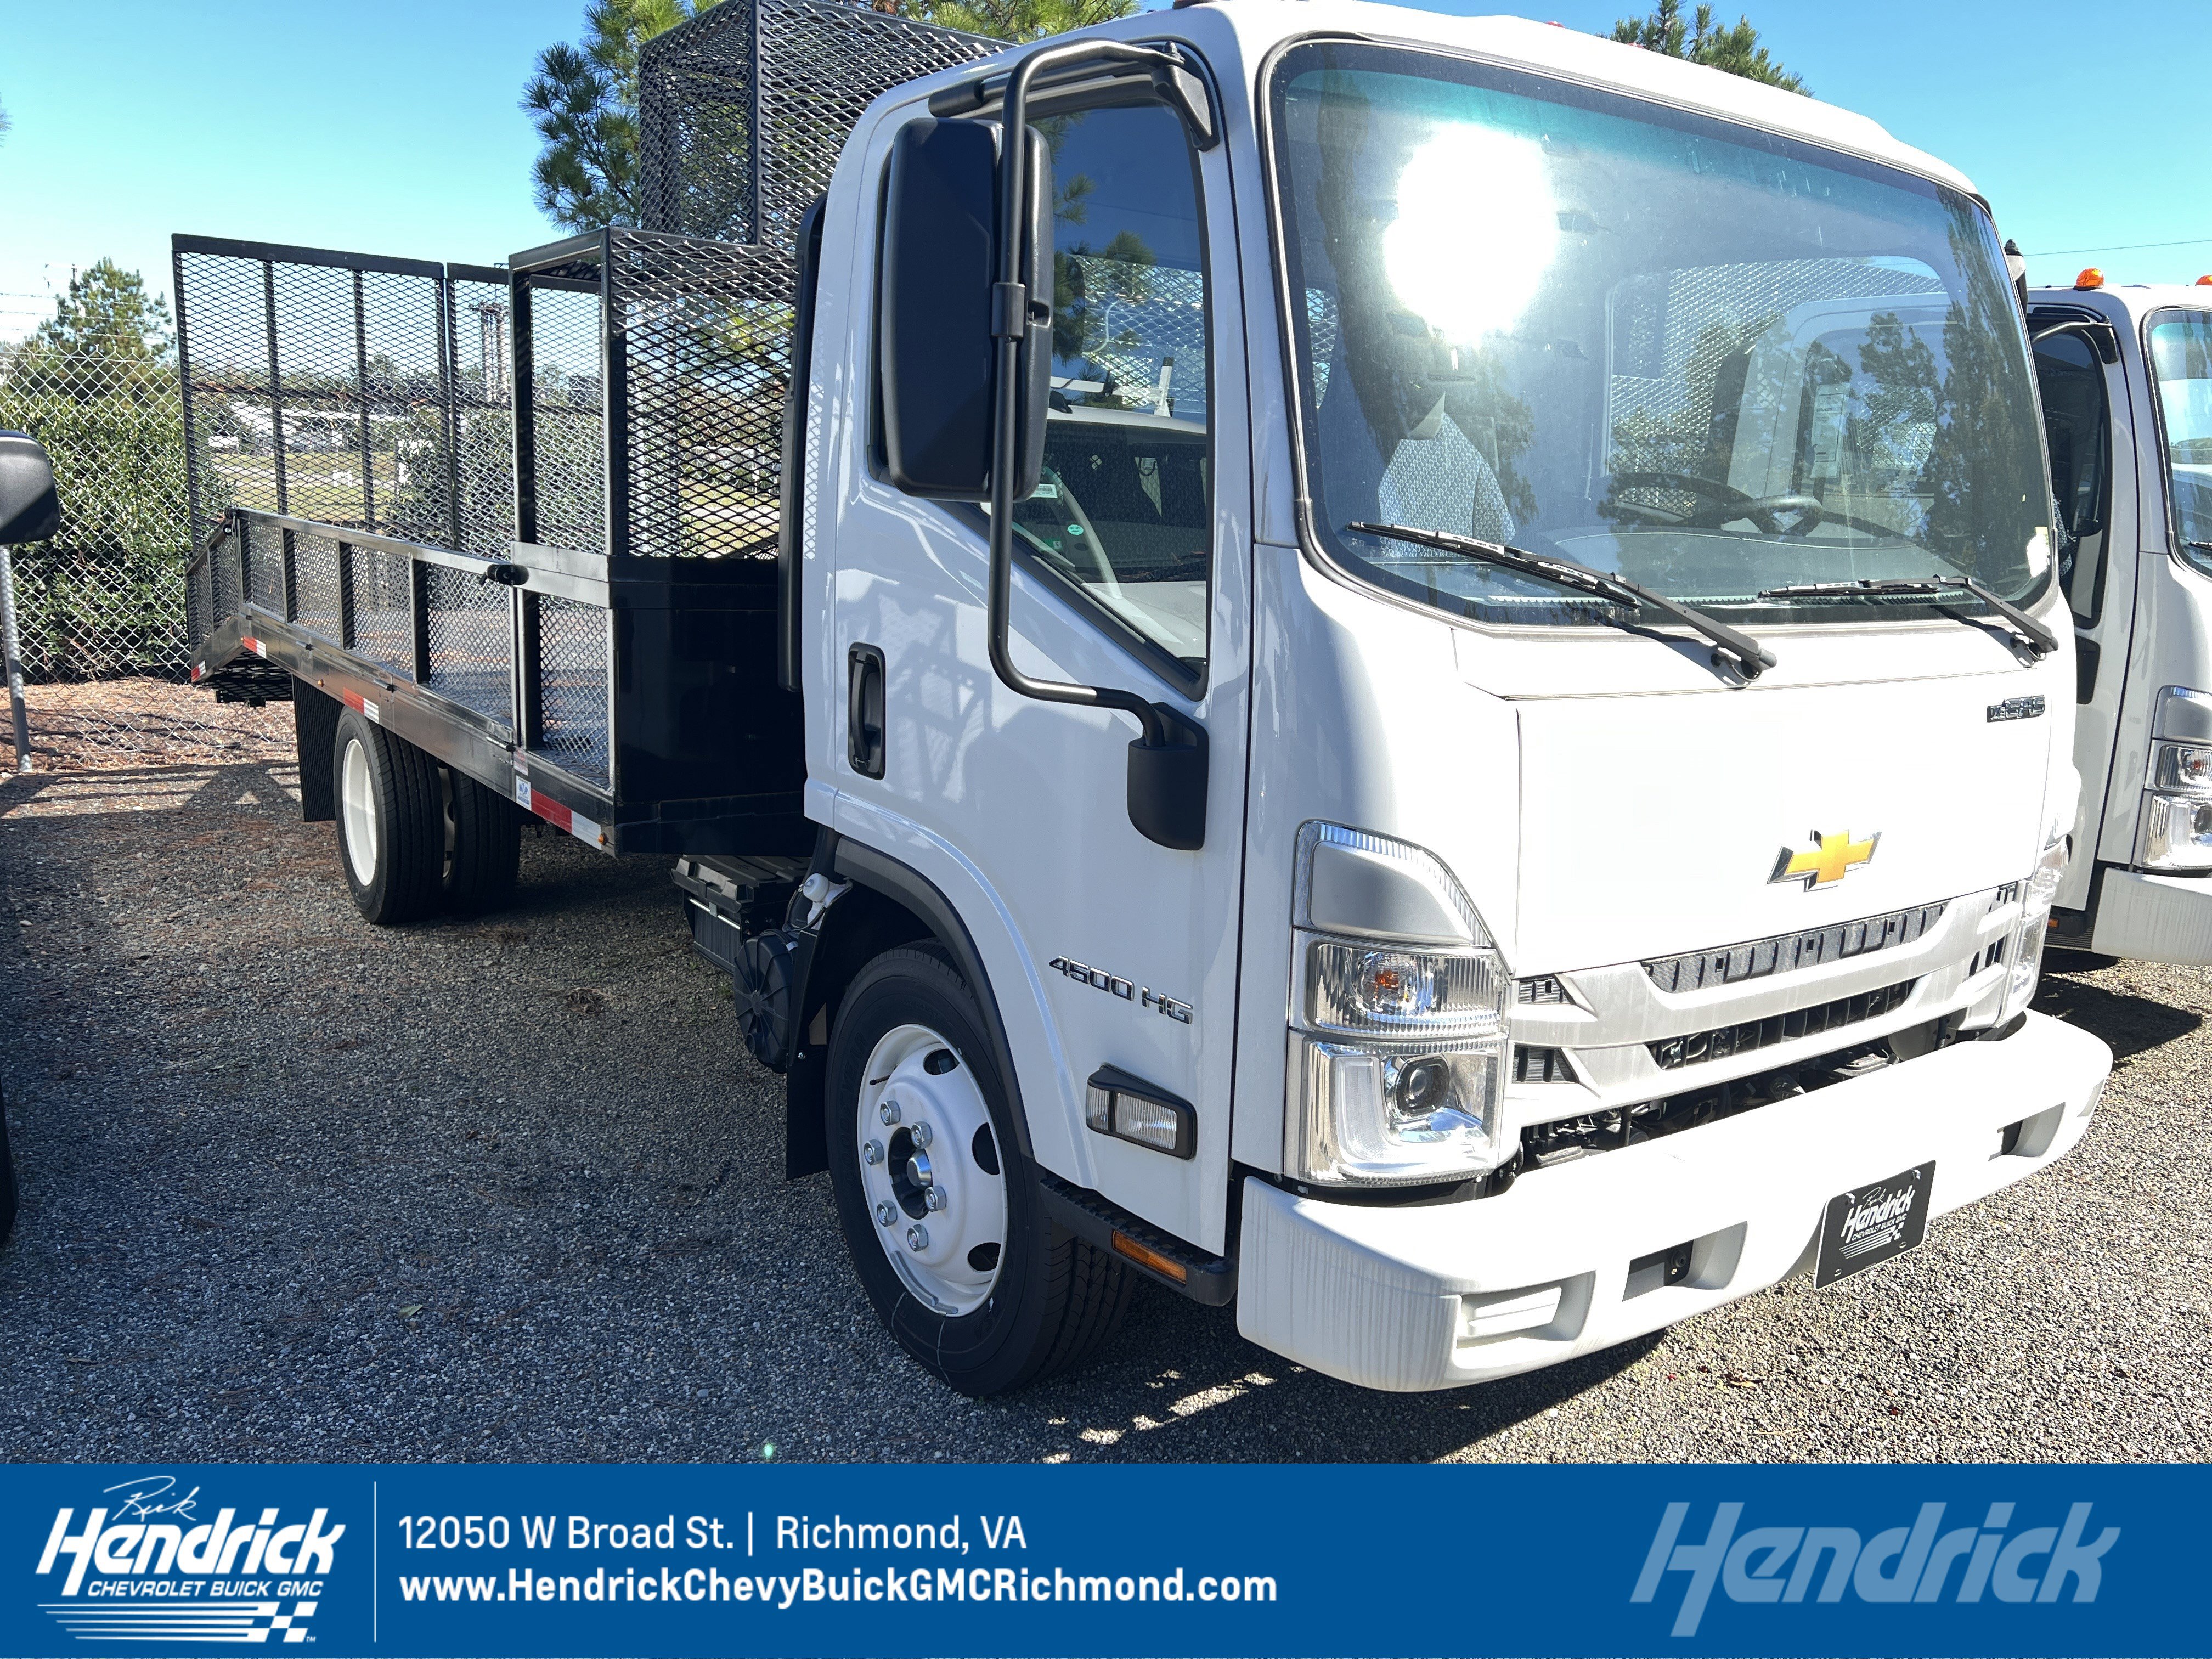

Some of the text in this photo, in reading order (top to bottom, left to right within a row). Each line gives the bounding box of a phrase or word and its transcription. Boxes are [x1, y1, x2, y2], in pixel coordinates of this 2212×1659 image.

[1049, 956, 1193, 1025] 4500 HG
[838, 1031, 868, 1188] GOODYEAR
[1841, 1184, 1916, 1244] Hendrick
[1852, 1223, 1882, 1242] CHEVROLET
[1880, 1217, 1896, 1230] BUICK
